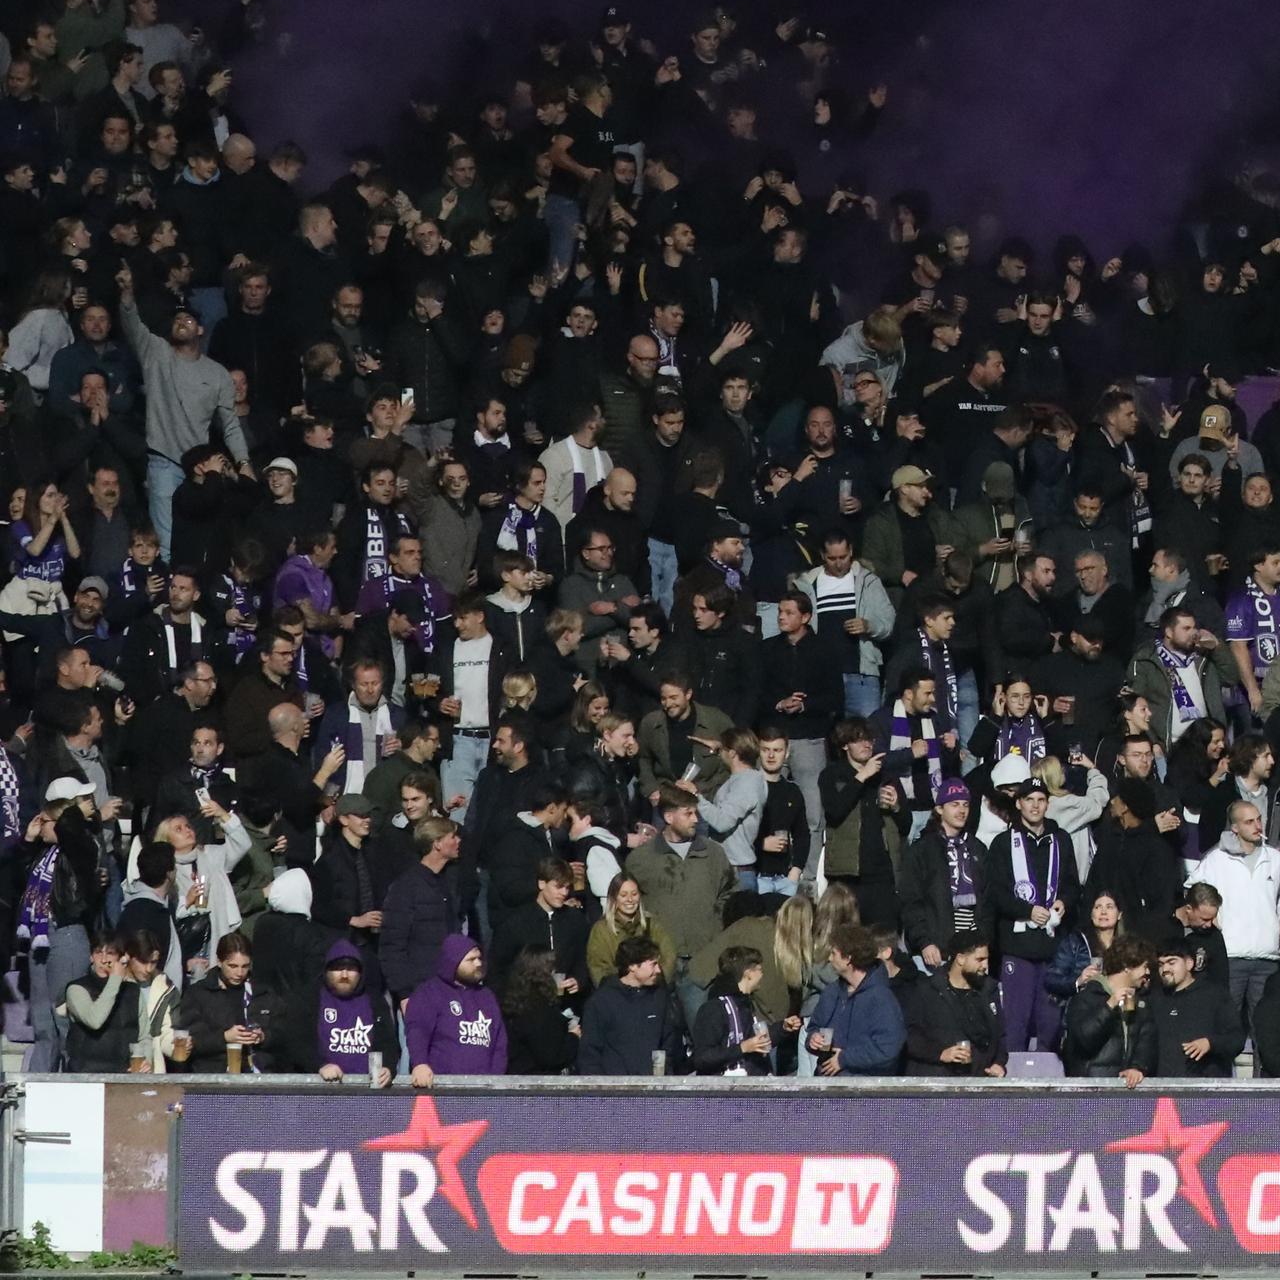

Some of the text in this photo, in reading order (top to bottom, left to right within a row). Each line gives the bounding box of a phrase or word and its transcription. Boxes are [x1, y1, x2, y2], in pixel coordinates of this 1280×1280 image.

[330, 1026, 372, 1047] STAR
[459, 1036, 490, 1048] CASINO
[329, 1044, 368, 1054] CASINO
[209, 1148, 881, 1254] STAR CASINO TV
[956, 1150, 1187, 1254] STAR
